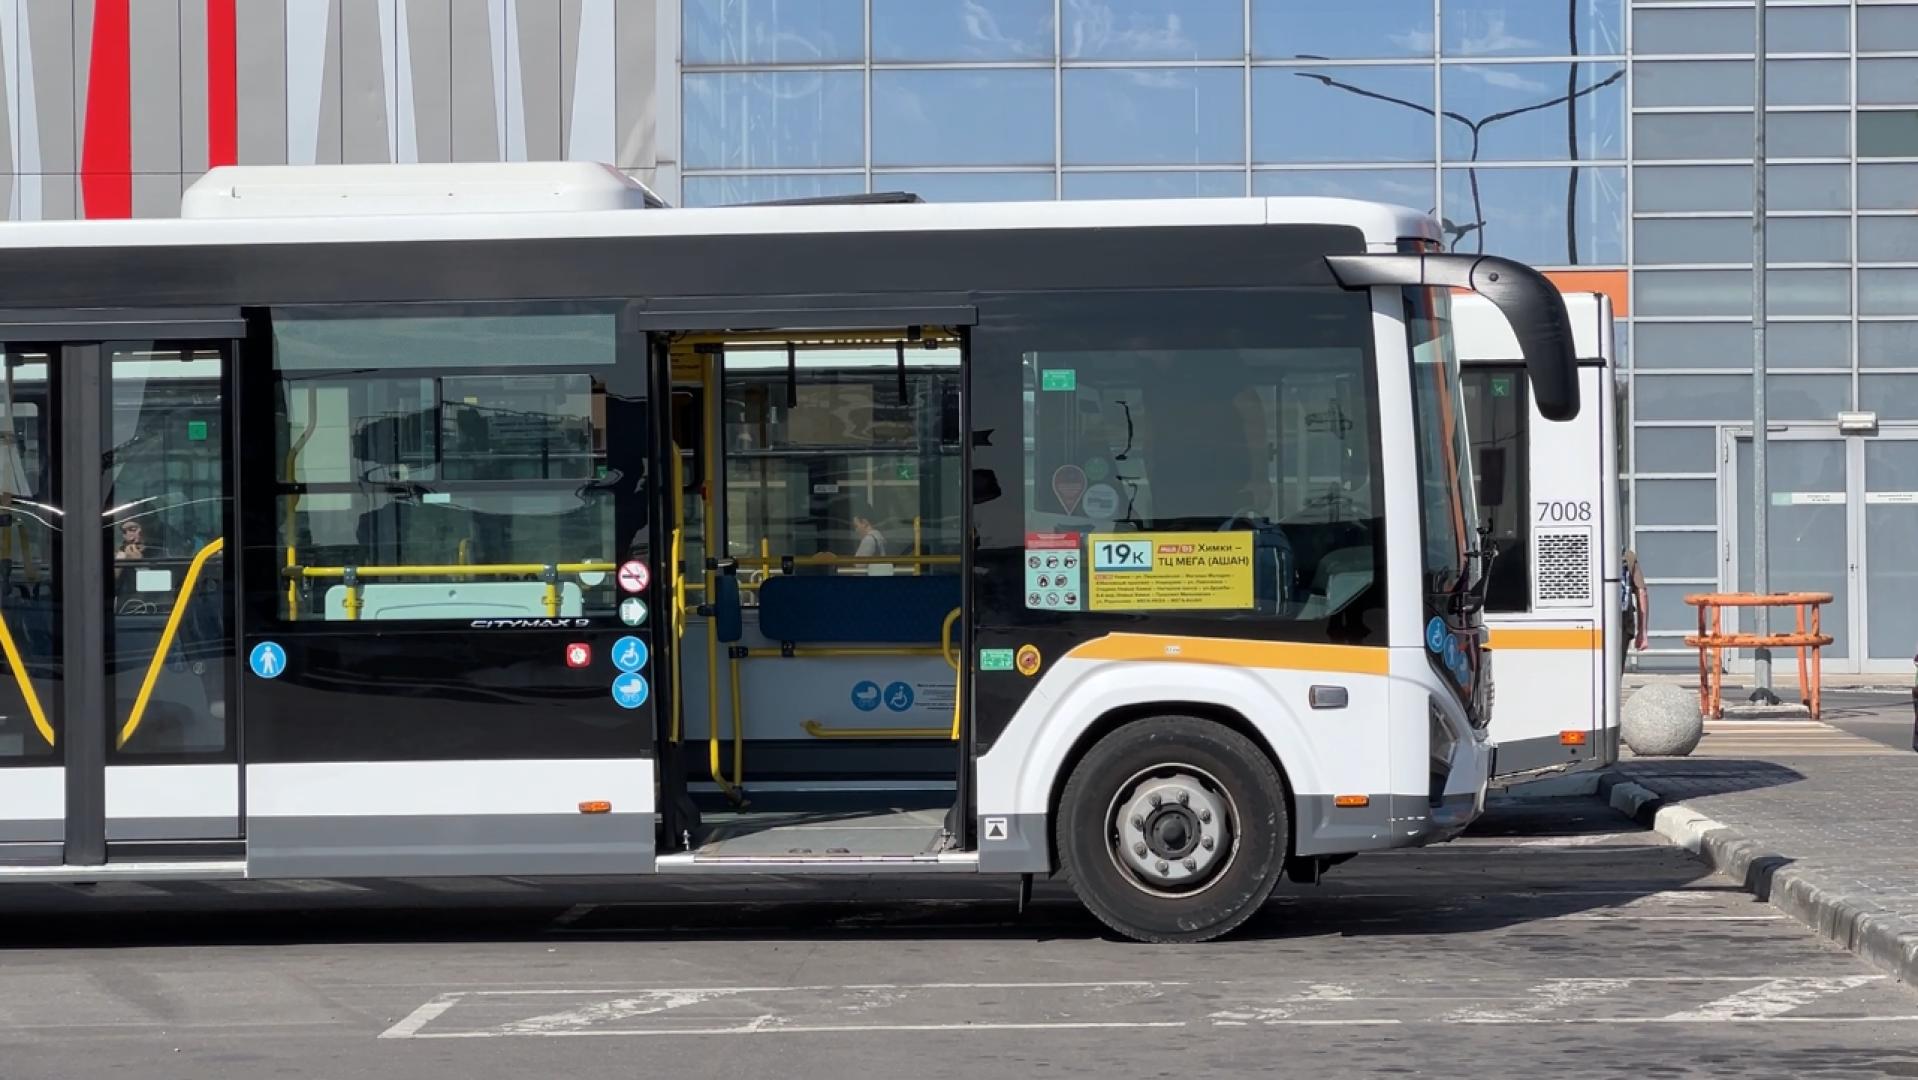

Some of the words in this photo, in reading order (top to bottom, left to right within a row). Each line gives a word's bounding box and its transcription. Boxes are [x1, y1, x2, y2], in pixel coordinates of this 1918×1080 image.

[1537, 501, 1591, 521] 7008
[1198, 543, 1232, 552] Химки
[1158, 556, 1173, 567] ТЦ
[1176, 556, 1206, 565] МЕГА
[1208, 555, 1250, 566] (АШАН)
[471, 619, 570, 628] CITYMAX
